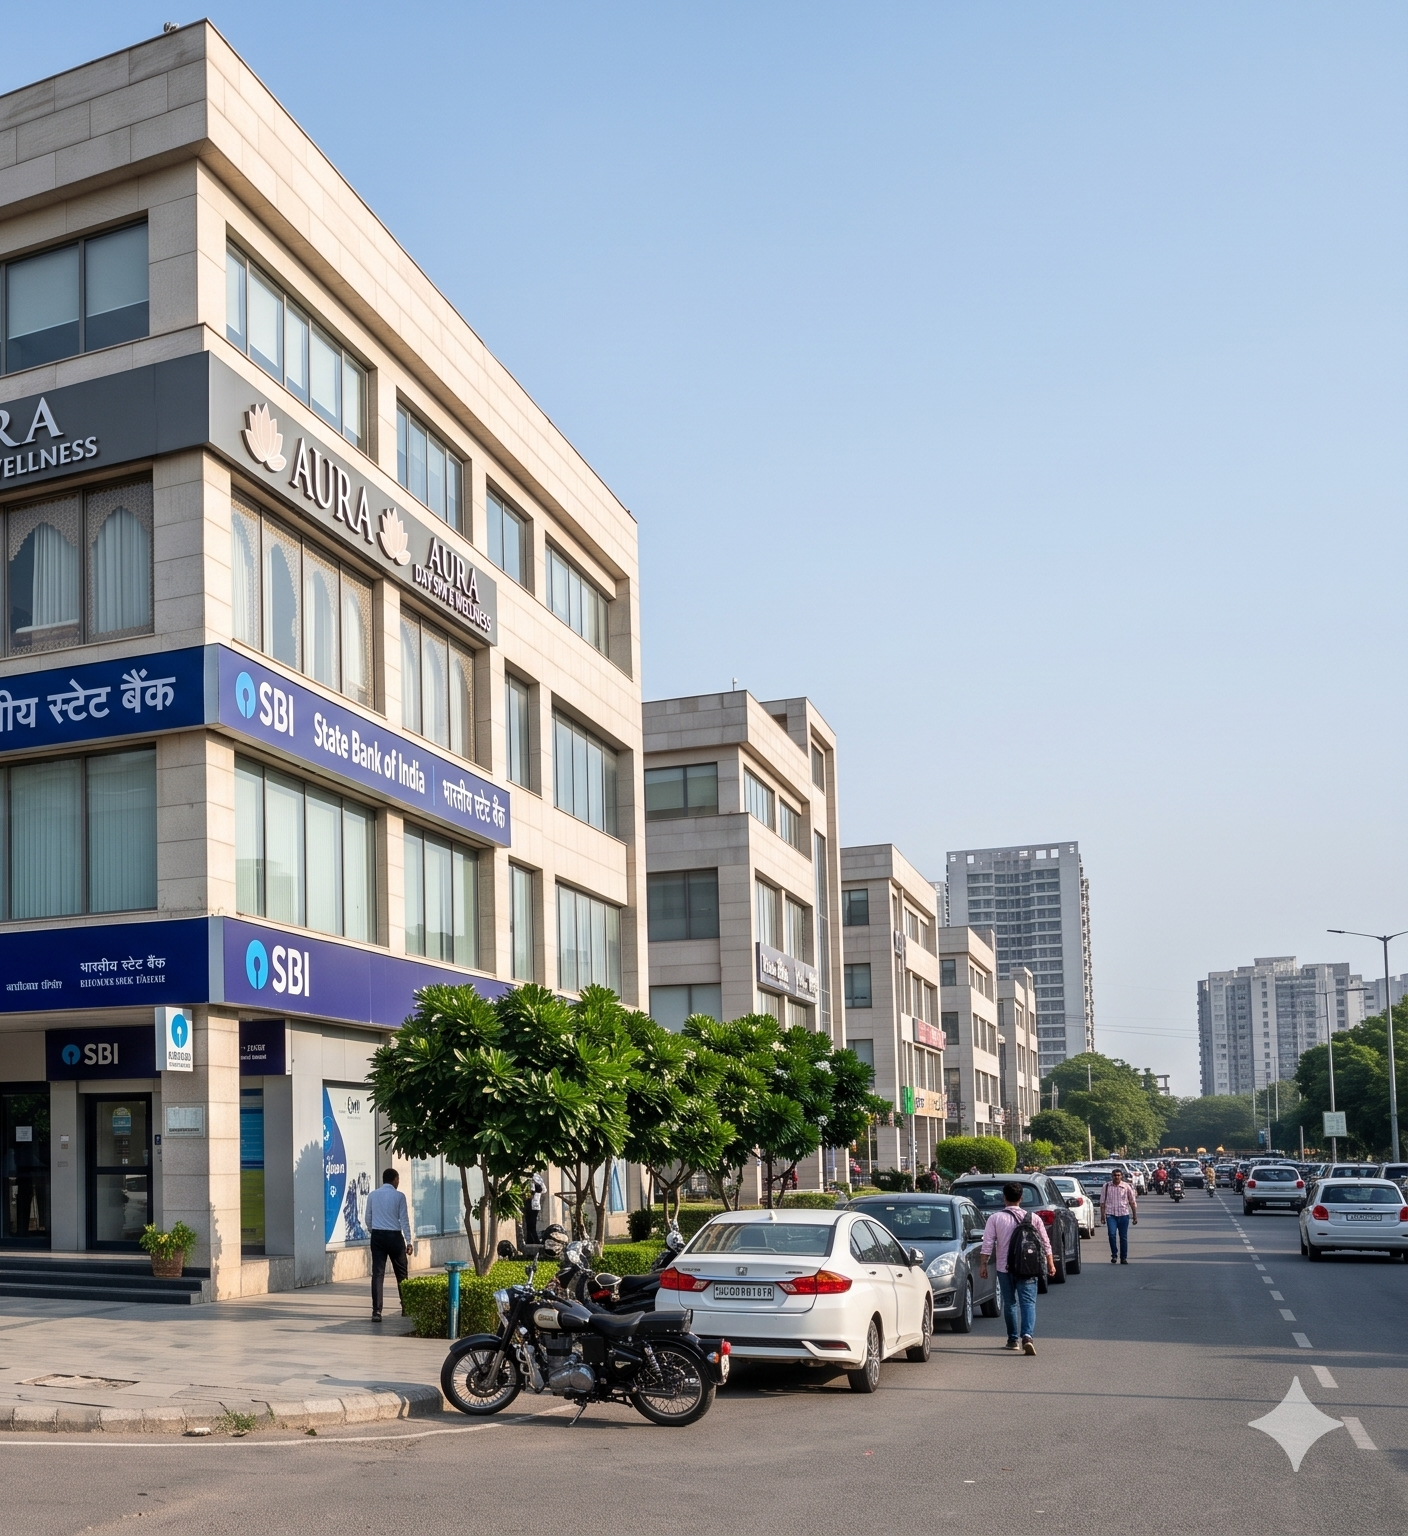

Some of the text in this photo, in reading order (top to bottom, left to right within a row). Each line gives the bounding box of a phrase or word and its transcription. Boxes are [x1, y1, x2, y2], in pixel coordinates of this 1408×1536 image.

[289, 437, 375, 545] AURA
[425, 536, 481, 605] AURA
[47, 678, 111, 724] स्टेट
[120, 668, 176, 714] बैंक
[259, 681, 294, 737] SBI
[314, 712, 425, 795] State Bank of India
[272, 945, 310, 997] SBI
[84, 1043, 119, 1065] SBI
